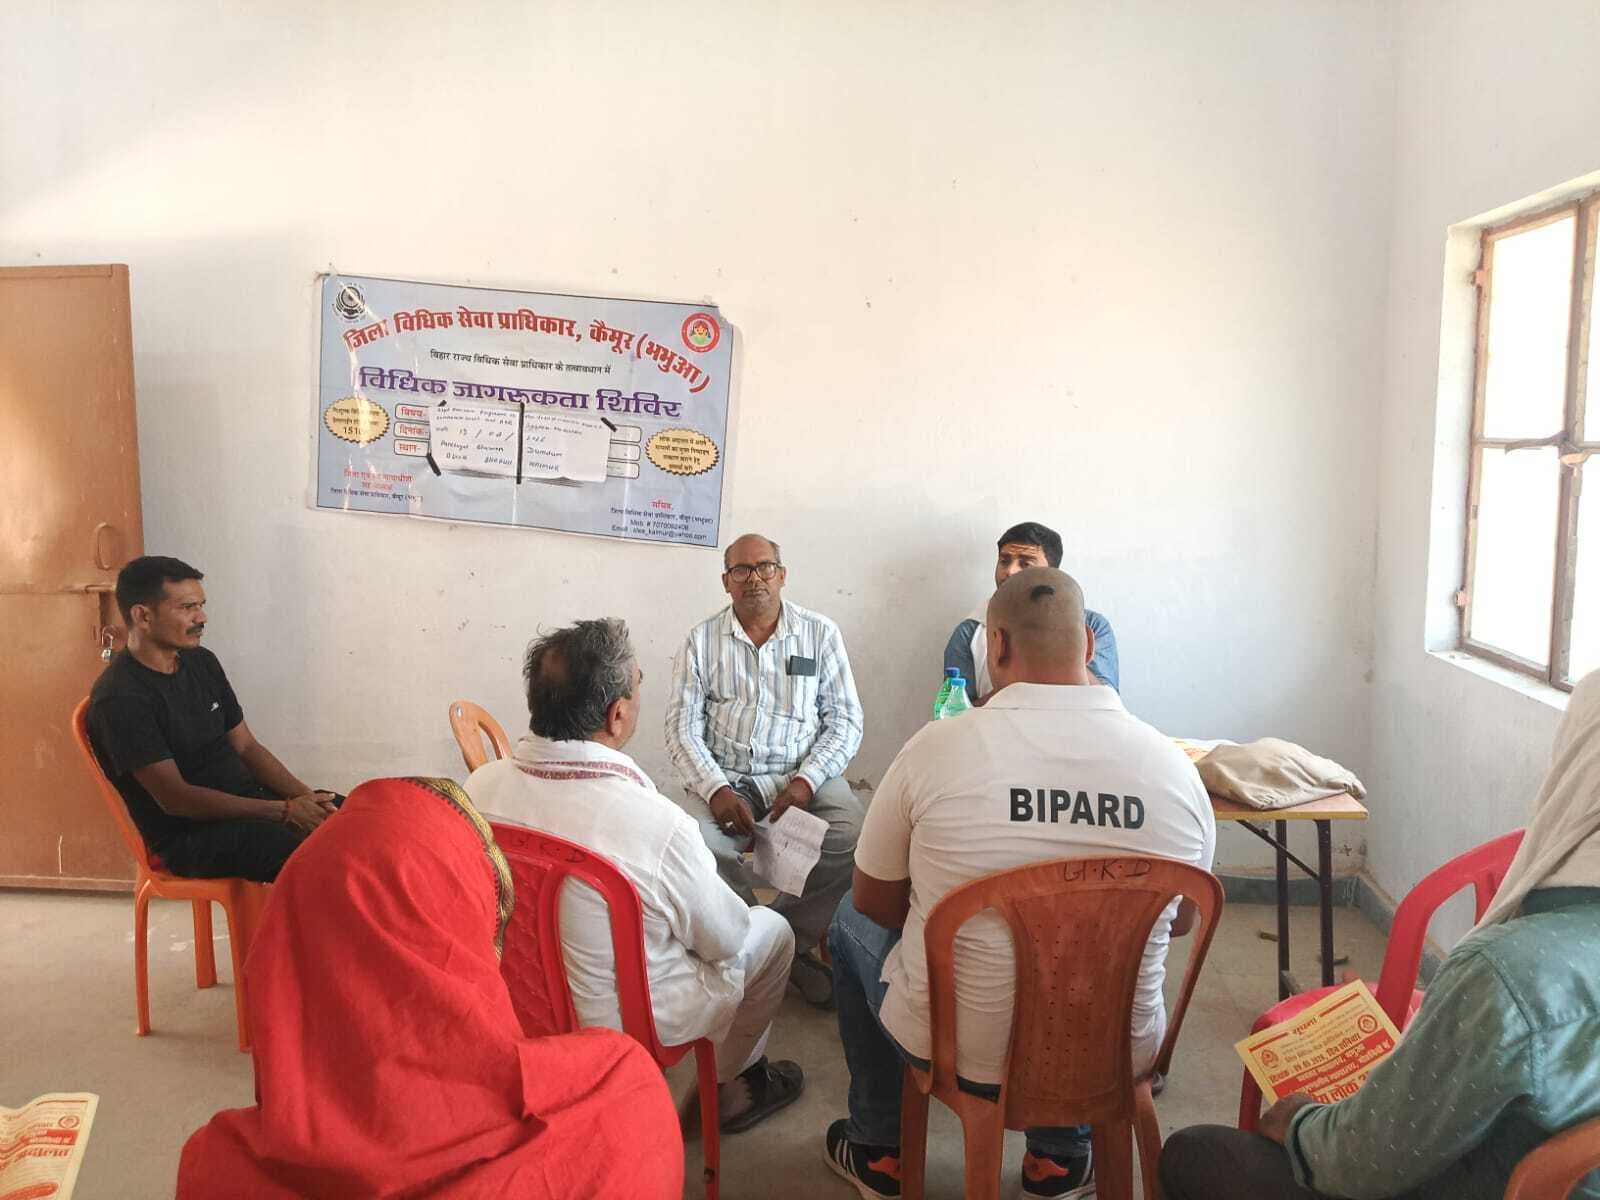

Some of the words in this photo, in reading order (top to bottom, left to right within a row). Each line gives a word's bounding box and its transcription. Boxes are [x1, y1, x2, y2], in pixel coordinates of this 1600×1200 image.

[343, 319, 389, 351] जिला
[394, 309, 453, 333] विधिक
[458, 306, 494, 328] सेवा
[497, 308, 582, 341] प्राधिकार,
[590, 319, 635, 353] कैमूर
[636, 333, 710, 393] (भभुआ)
[430, 348, 450, 360] बिहार
[453, 352, 472, 363] राज्य
[474, 352, 500, 365] विधिक
[503, 355, 518, 368] सेवा
[520, 358, 553, 371] प्राधिकार
[555, 360, 564, 371] के
[604, 363, 612, 374] में
[359, 366, 447, 394] विधिक
[452, 381, 590, 409] जागरूकता
[596, 389, 683, 417] शिविर
[1009, 788, 1145, 830] BIPARD
